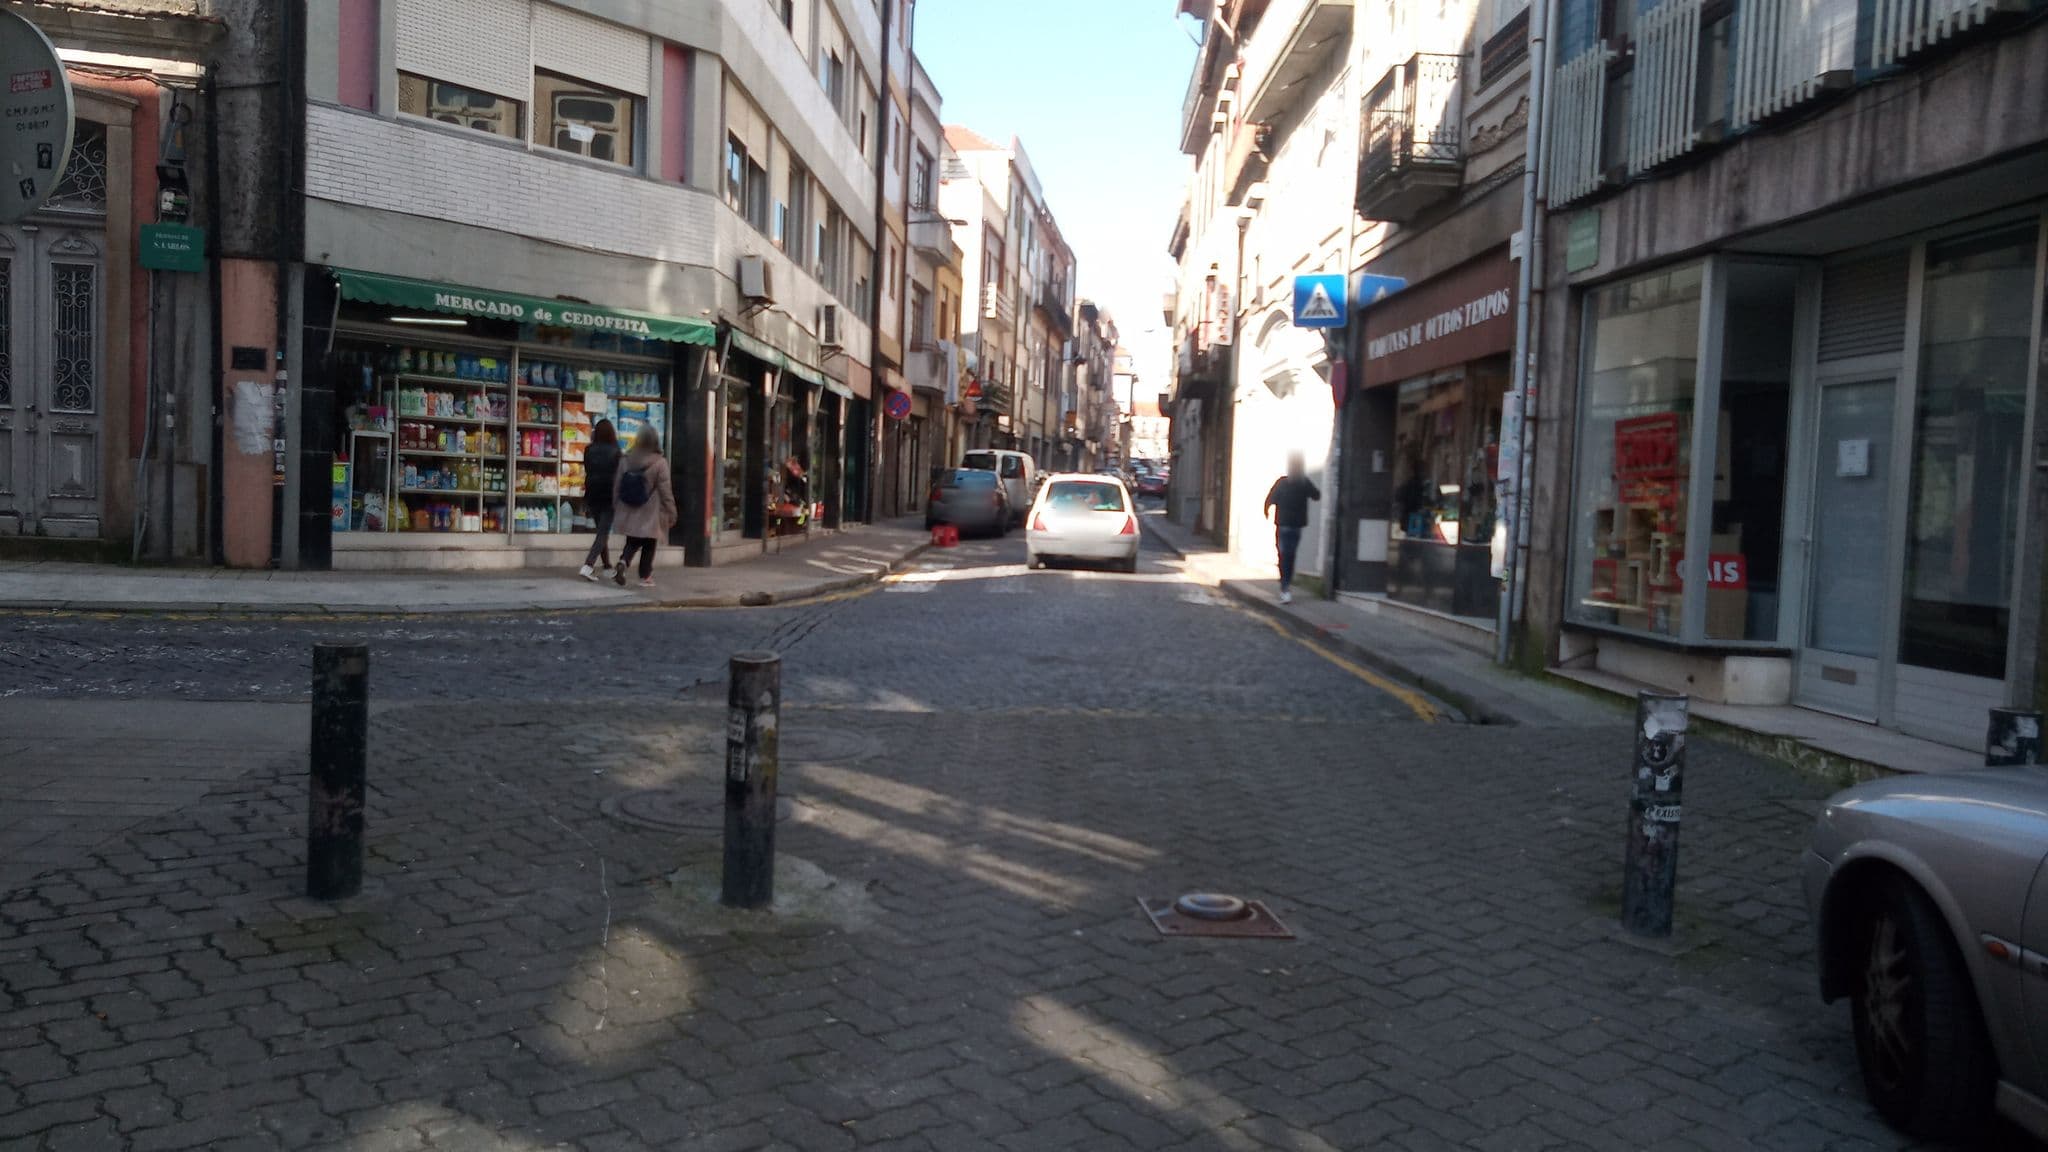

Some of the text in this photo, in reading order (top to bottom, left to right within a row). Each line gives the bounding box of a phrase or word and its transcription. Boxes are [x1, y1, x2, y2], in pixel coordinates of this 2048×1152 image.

[435, 293, 650, 334] MERCADO de CEDOFEITA
[1425, 305, 1463, 341] OUTROS
[1464, 288, 1510, 327] TEMPOS
